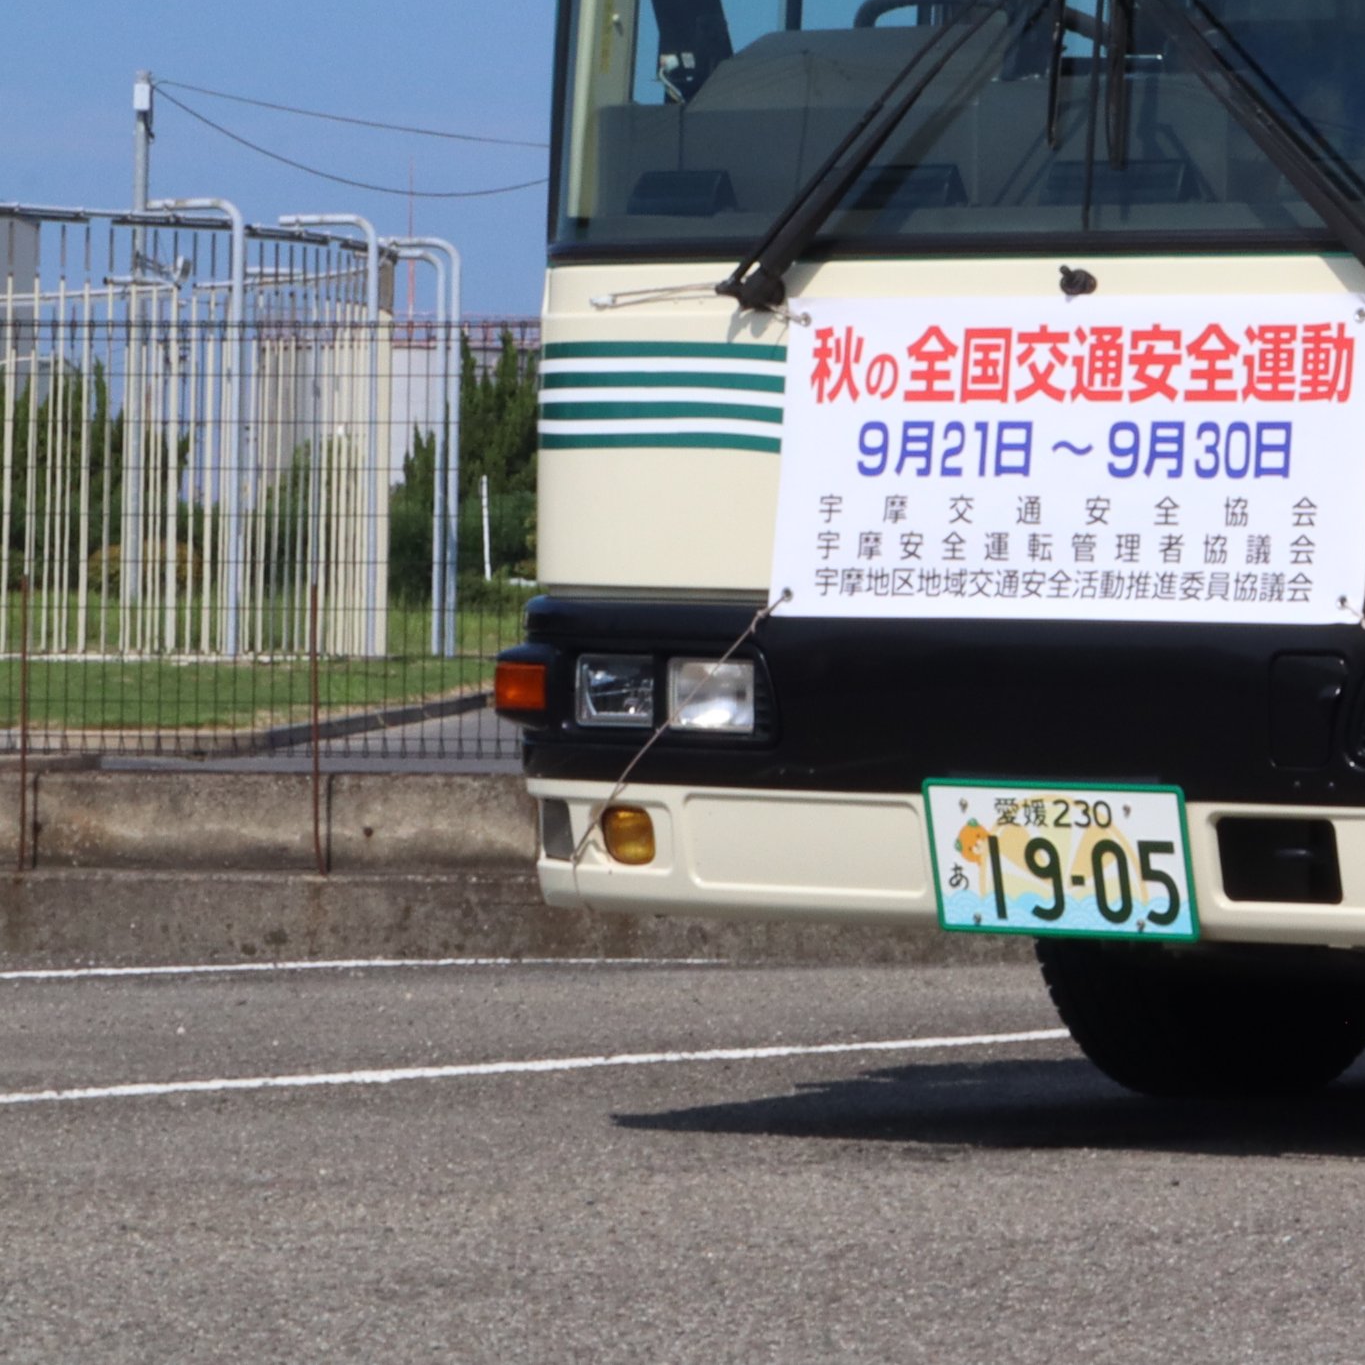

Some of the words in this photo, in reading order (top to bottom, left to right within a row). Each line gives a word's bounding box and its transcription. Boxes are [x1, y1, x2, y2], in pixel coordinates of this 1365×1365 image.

[811, 322, 1355, 404] 秋の全国交通安全運動
[818, 494, 1318, 527] 宇摩交通安全協会
[816, 531, 1317, 565] 宇摩安全運転管理者協議会
[814, 567, 1313, 603] 宇摩地区地域交通安全活動推進委員協議会
[948, 861, 969, 890] あ
[988, 835, 1180, 926] 19-05
